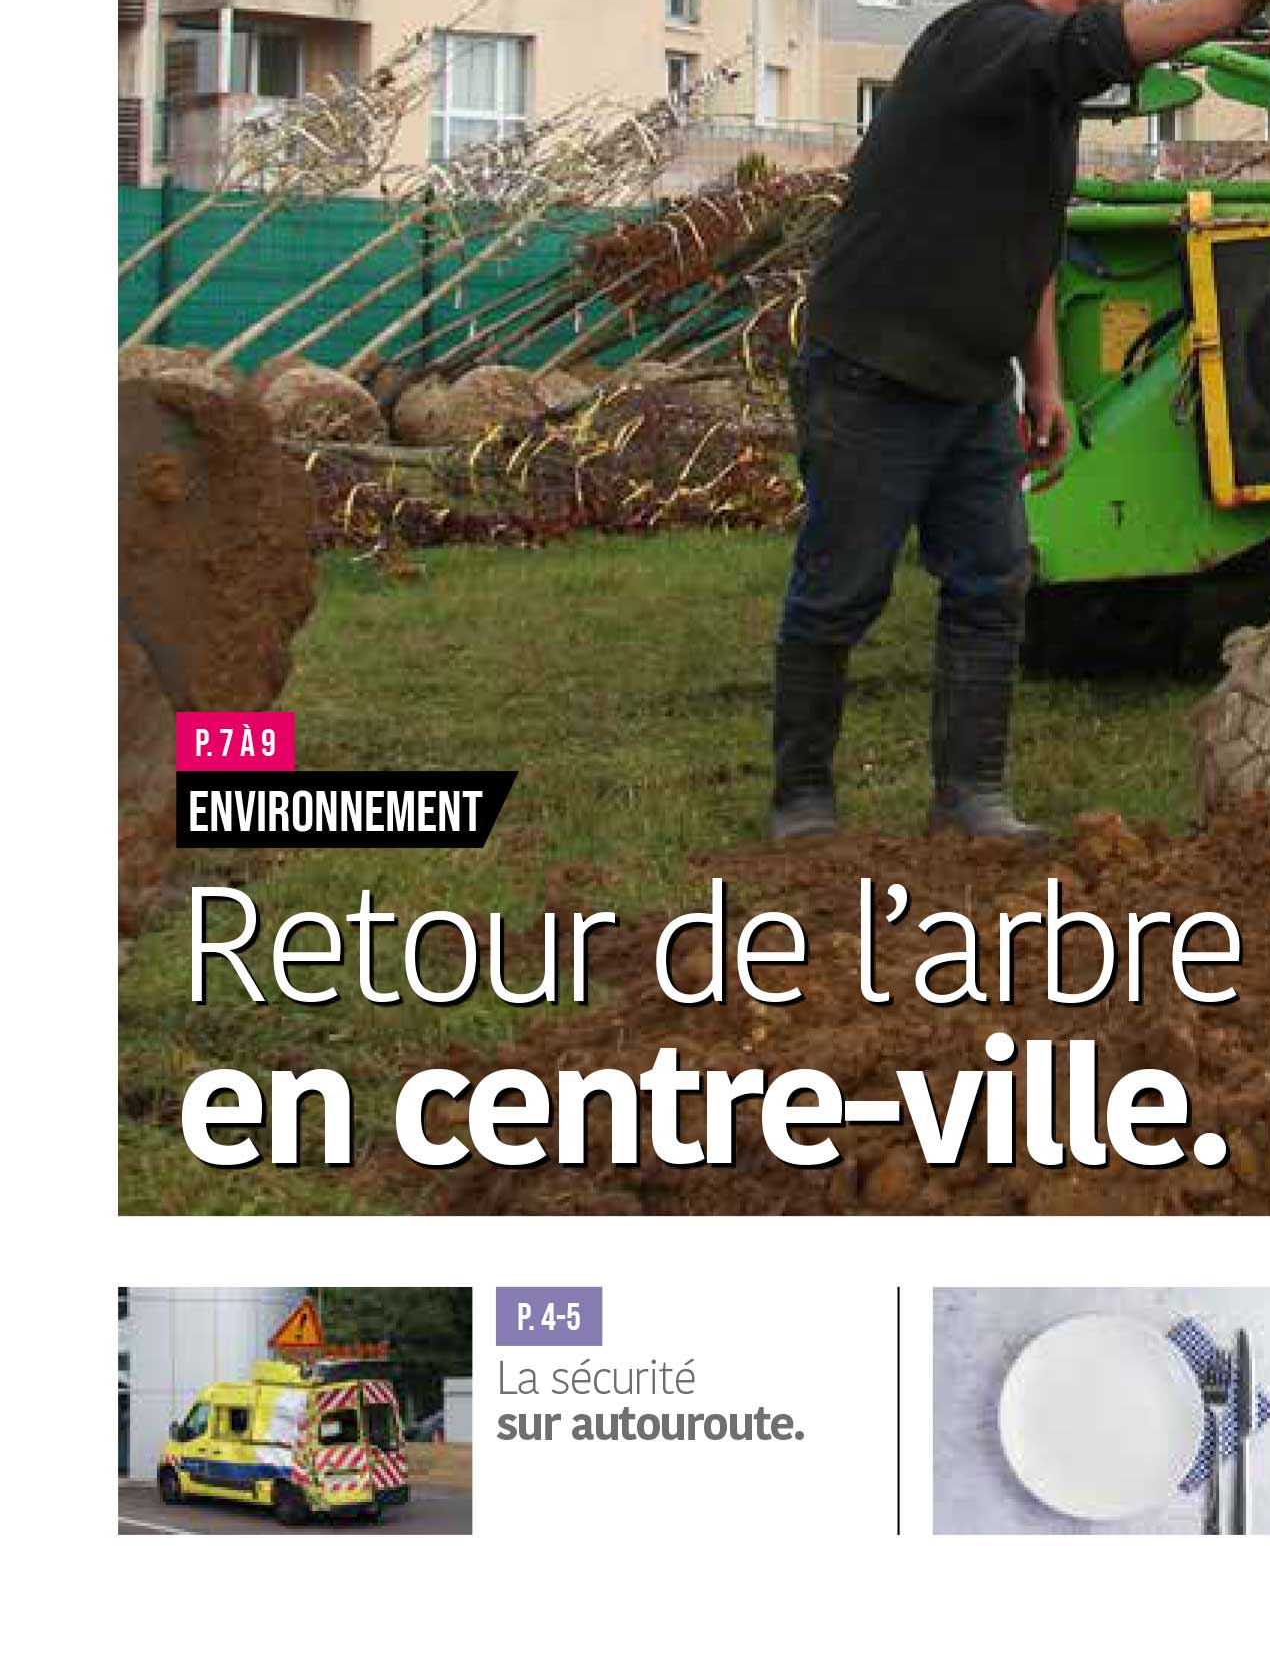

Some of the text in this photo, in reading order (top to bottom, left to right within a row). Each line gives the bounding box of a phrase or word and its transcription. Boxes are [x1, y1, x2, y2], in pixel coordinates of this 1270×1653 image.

[518, 1302, 581, 1331] P. 4-5
[499, 1358, 695, 1395] La sécurité
[496, 1406, 805, 1441] sur autouroute.
